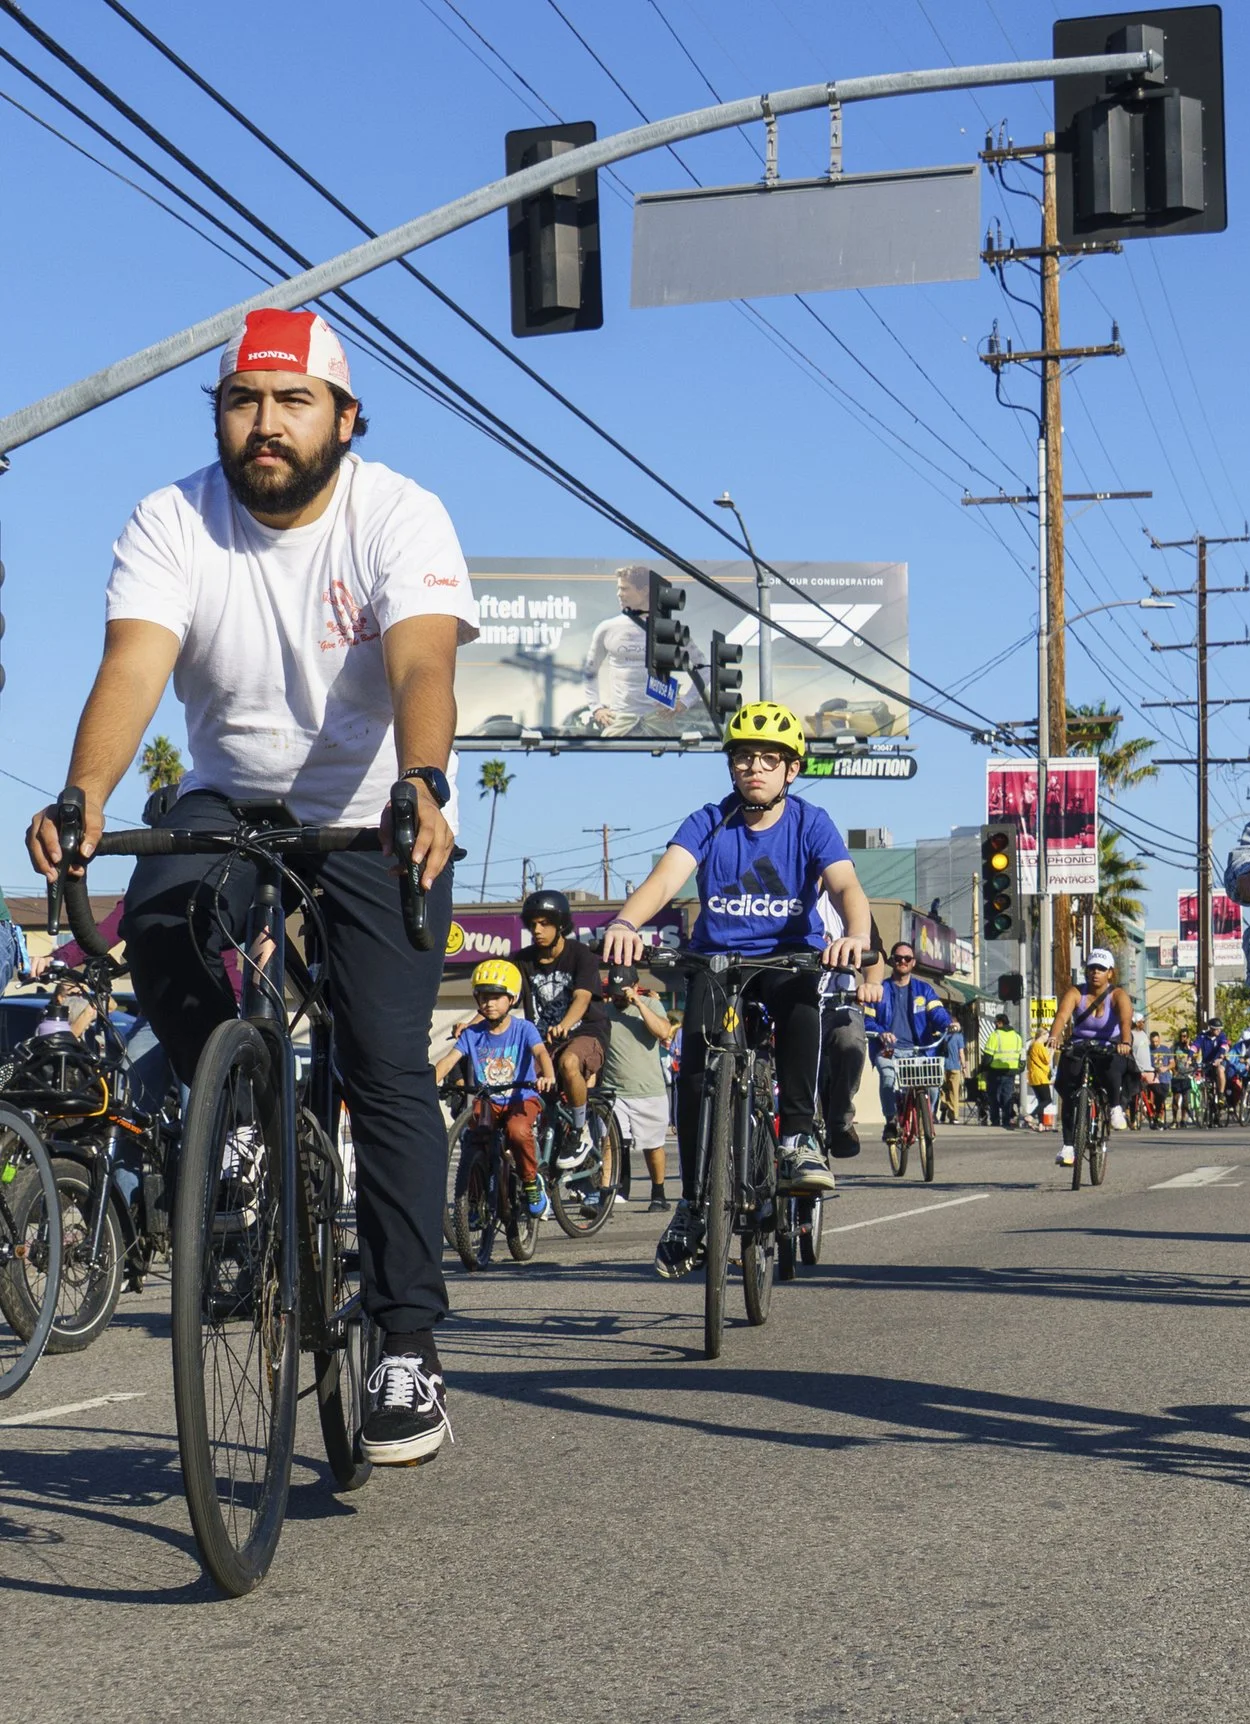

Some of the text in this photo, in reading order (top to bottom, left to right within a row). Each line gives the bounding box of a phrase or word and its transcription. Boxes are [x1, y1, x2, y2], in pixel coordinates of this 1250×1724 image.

[248, 351, 298, 362] HONDA
[810, 577, 884, 586] CONSIDERATION
[528, 594, 577, 619] with
[834, 758, 911, 777] TRADITION
[1047, 856, 1093, 864] PHONIC
[1049, 875, 1095, 884] PANTAGES
[708, 894, 804, 917] adidas
[464, 932, 511, 957] YUM
